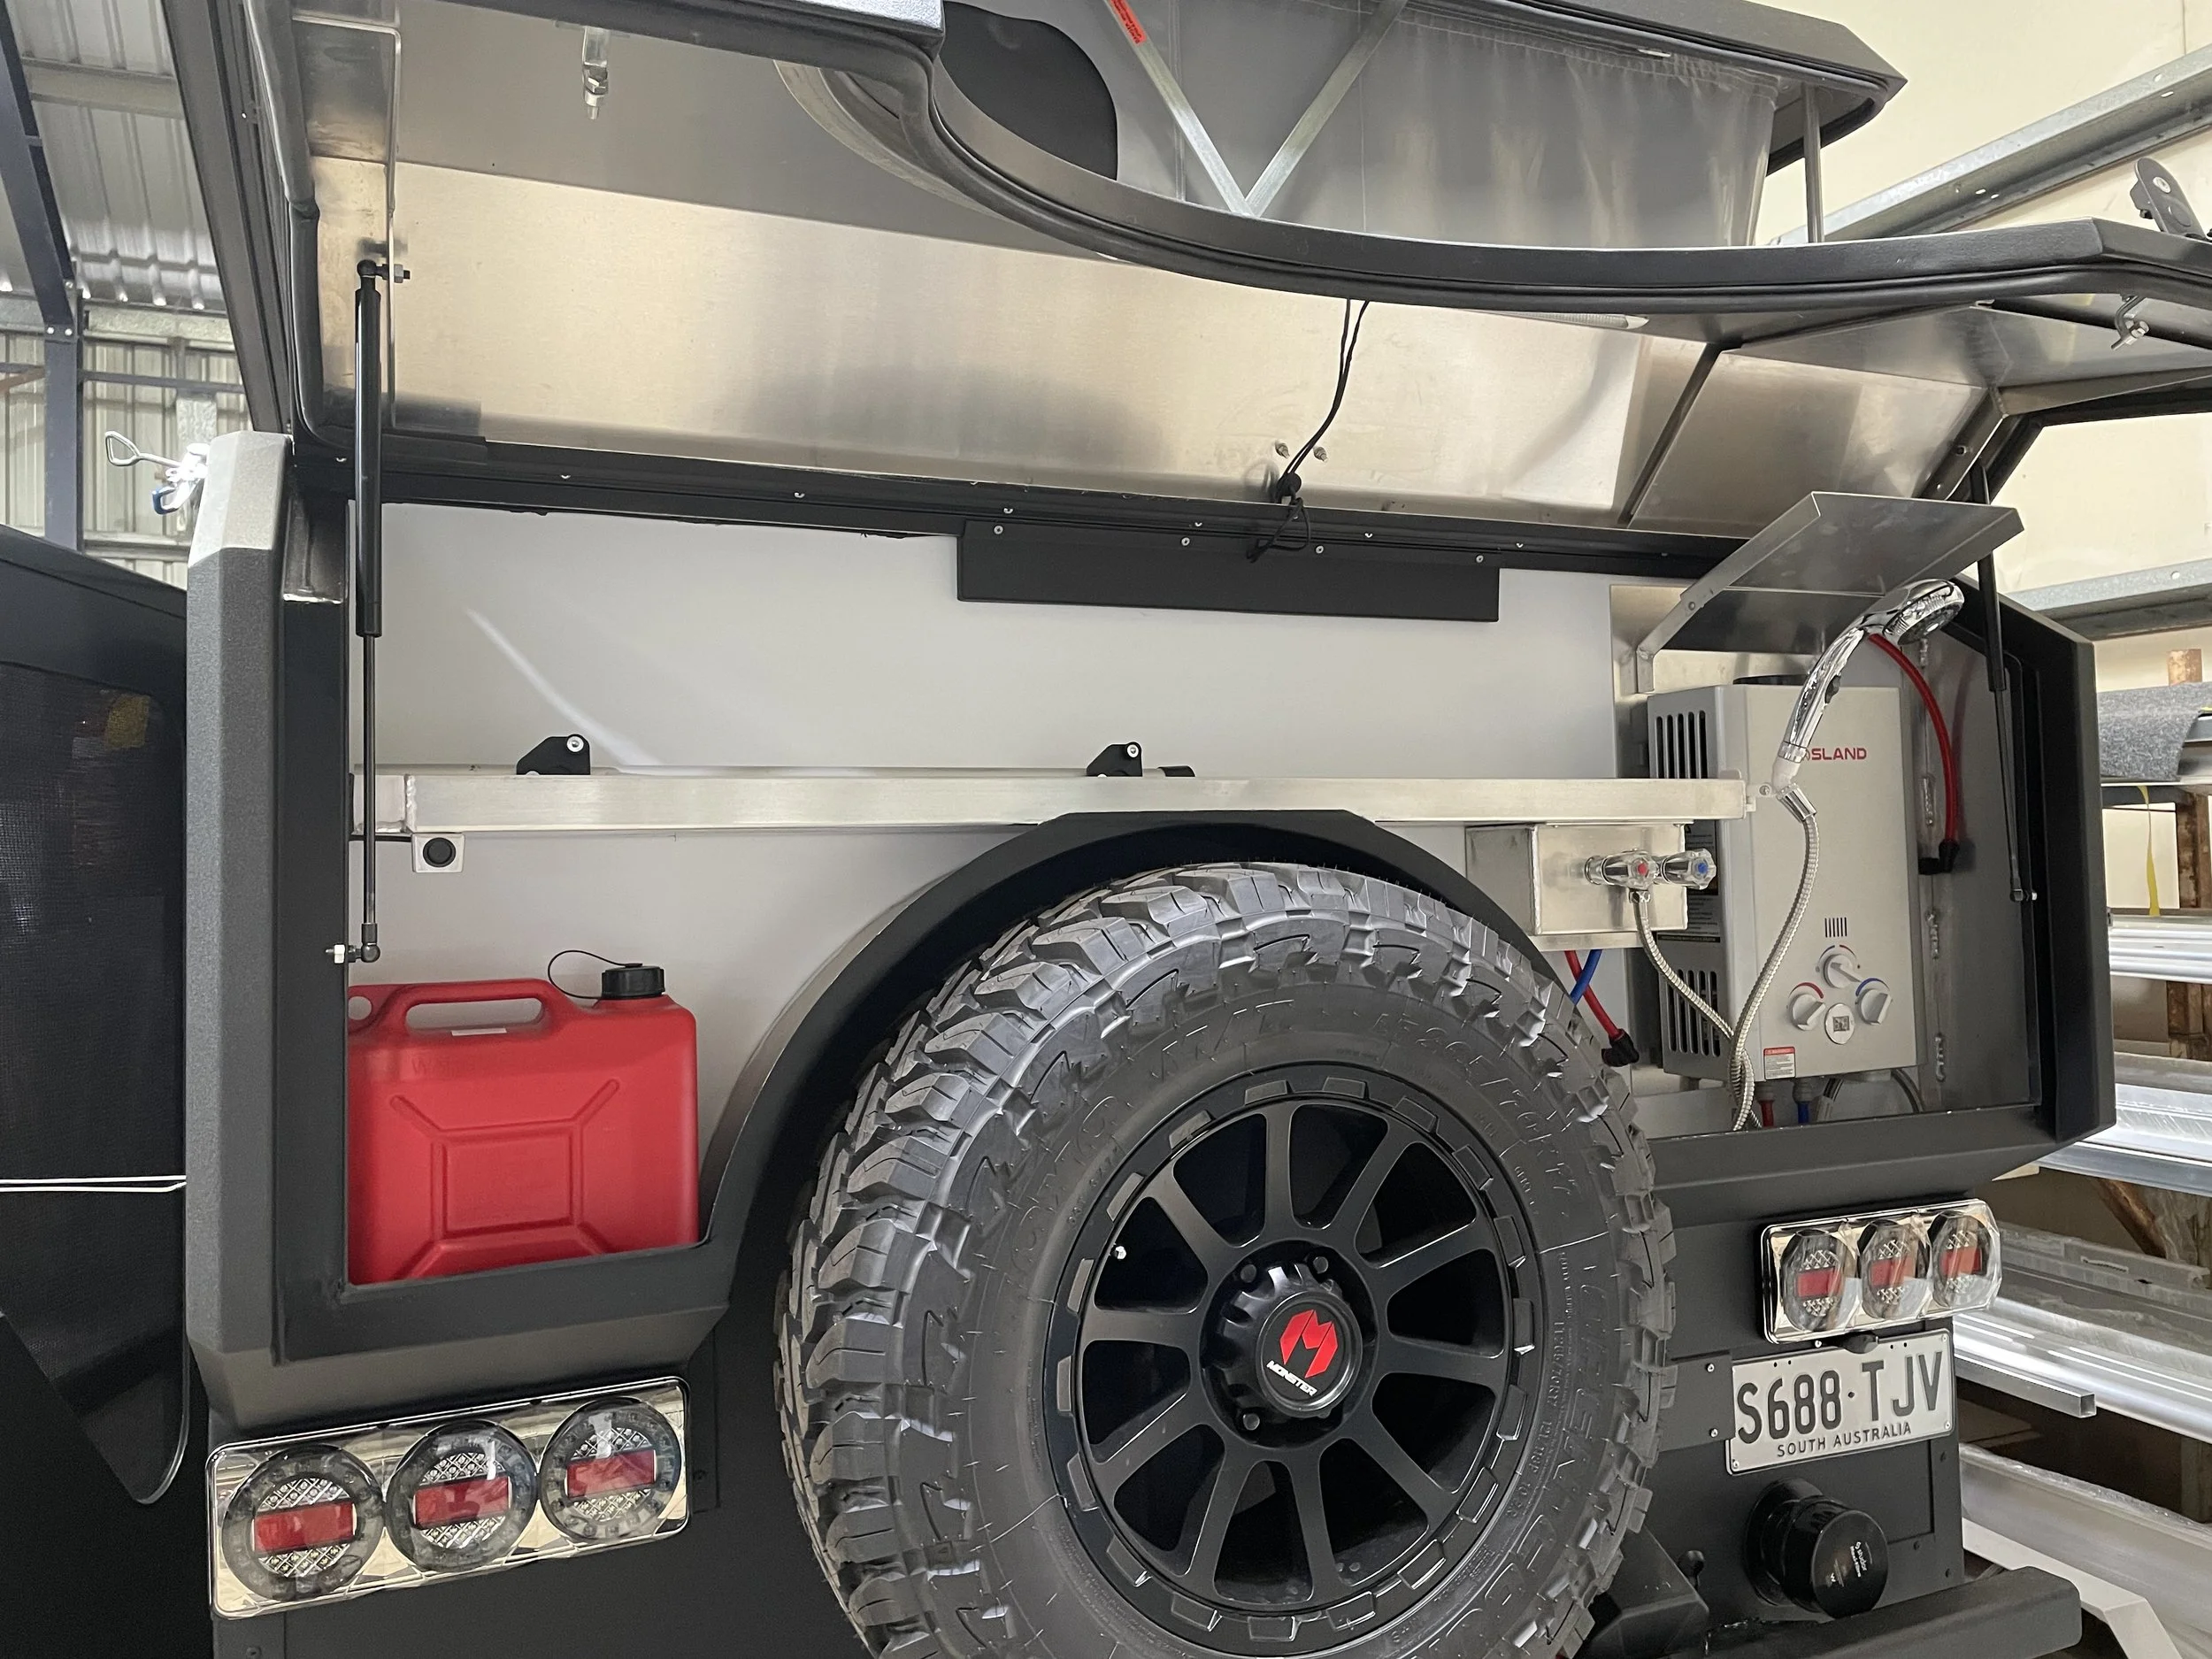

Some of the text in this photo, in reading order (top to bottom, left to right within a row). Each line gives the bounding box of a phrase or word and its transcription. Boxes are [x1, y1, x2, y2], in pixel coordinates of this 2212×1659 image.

[1805, 748, 1867, 761] SLAND
[1266, 1360, 1318, 1396] MONSTER
[1777, 1422, 1912, 1457] SOUTH AUSTRALIA
